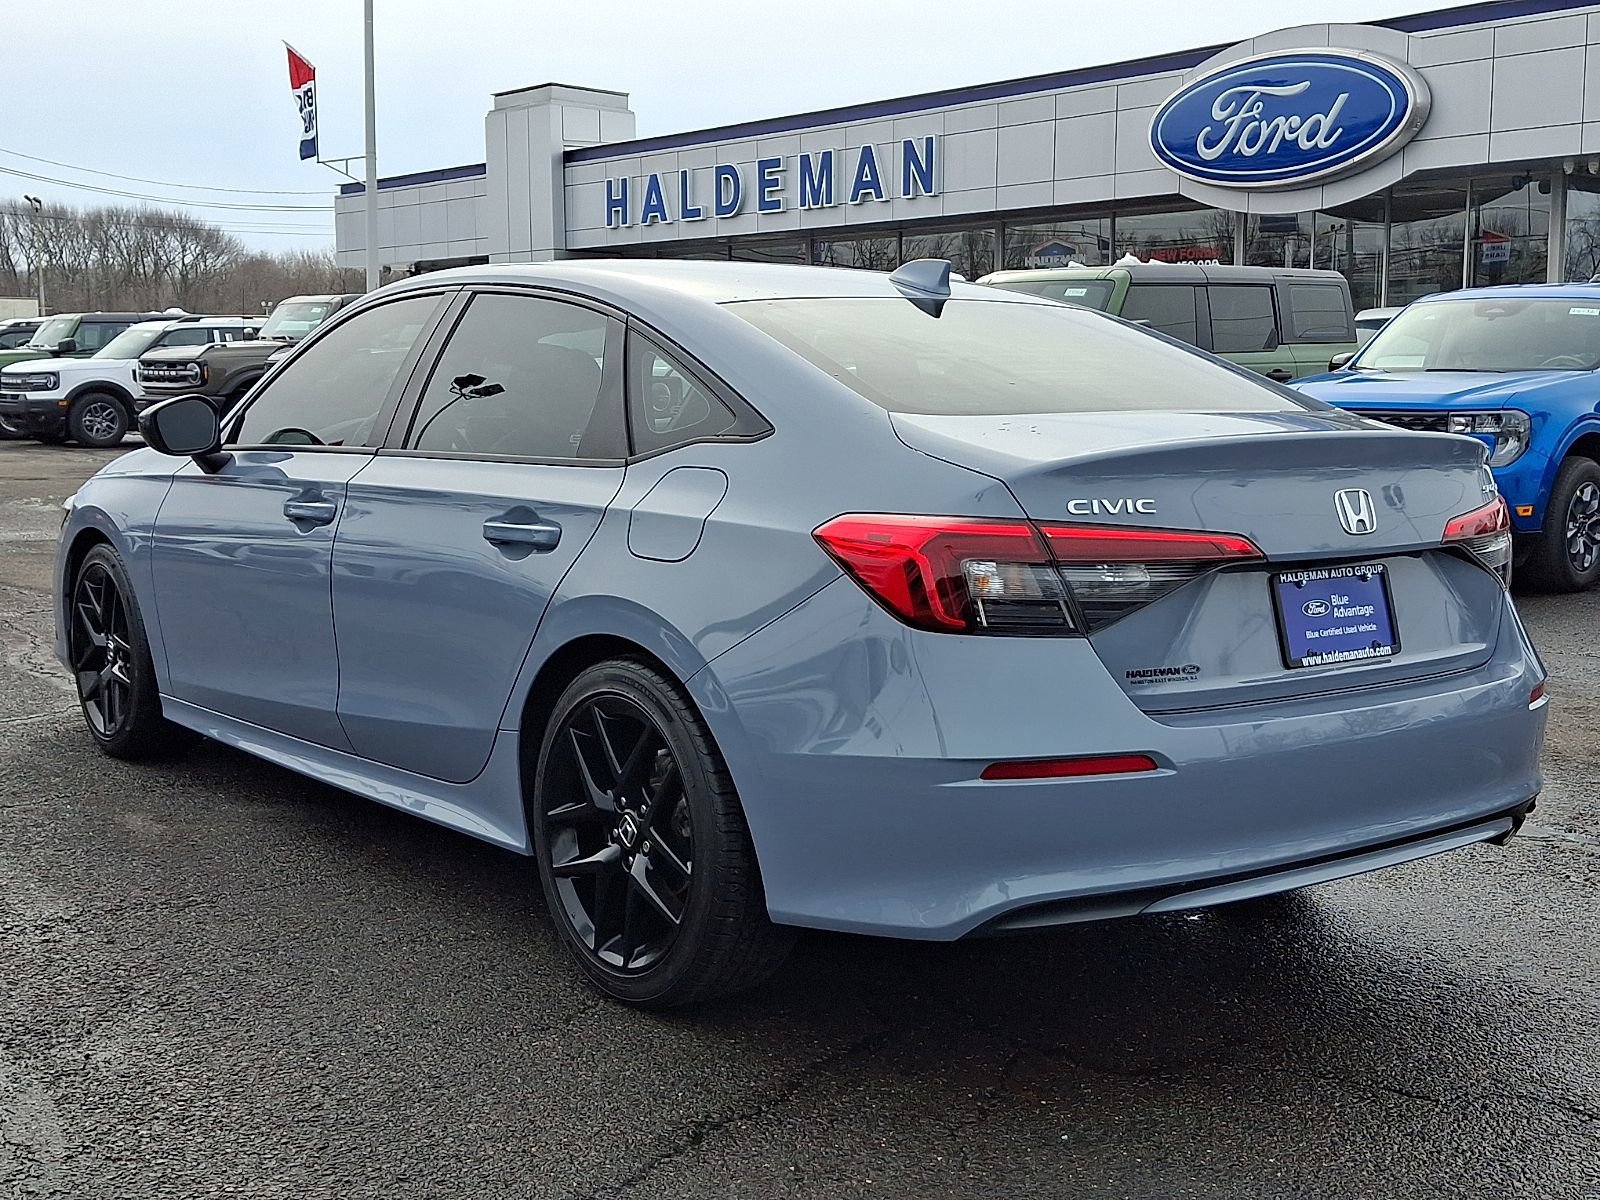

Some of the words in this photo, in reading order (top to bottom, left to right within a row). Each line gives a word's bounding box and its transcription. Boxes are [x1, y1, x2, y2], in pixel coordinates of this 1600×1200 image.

[1196, 80, 1349, 160] Ford
[604, 134, 940, 229] HALDEMAN
[1067, 498, 1156, 515] CIVIC
[1280, 570, 1329, 583] HALDEMAN
[1330, 567, 1353, 578] AUTO
[1355, 564, 1383, 576] GROUP
[1307, 602, 1326, 614] Ford
[1331, 594, 1349, 606] Blue
[1333, 604, 1374, 618] Advantage
[1305, 629, 1320, 639] Blue
[1319, 626, 1343, 637] Certified
[1343, 625, 1358, 635] Used
[1358, 622, 1377, 633] Vehicle
[1301, 645, 1392, 666] www.haldemanauto.com
[1125, 666, 1181, 678] HALDEMAN
